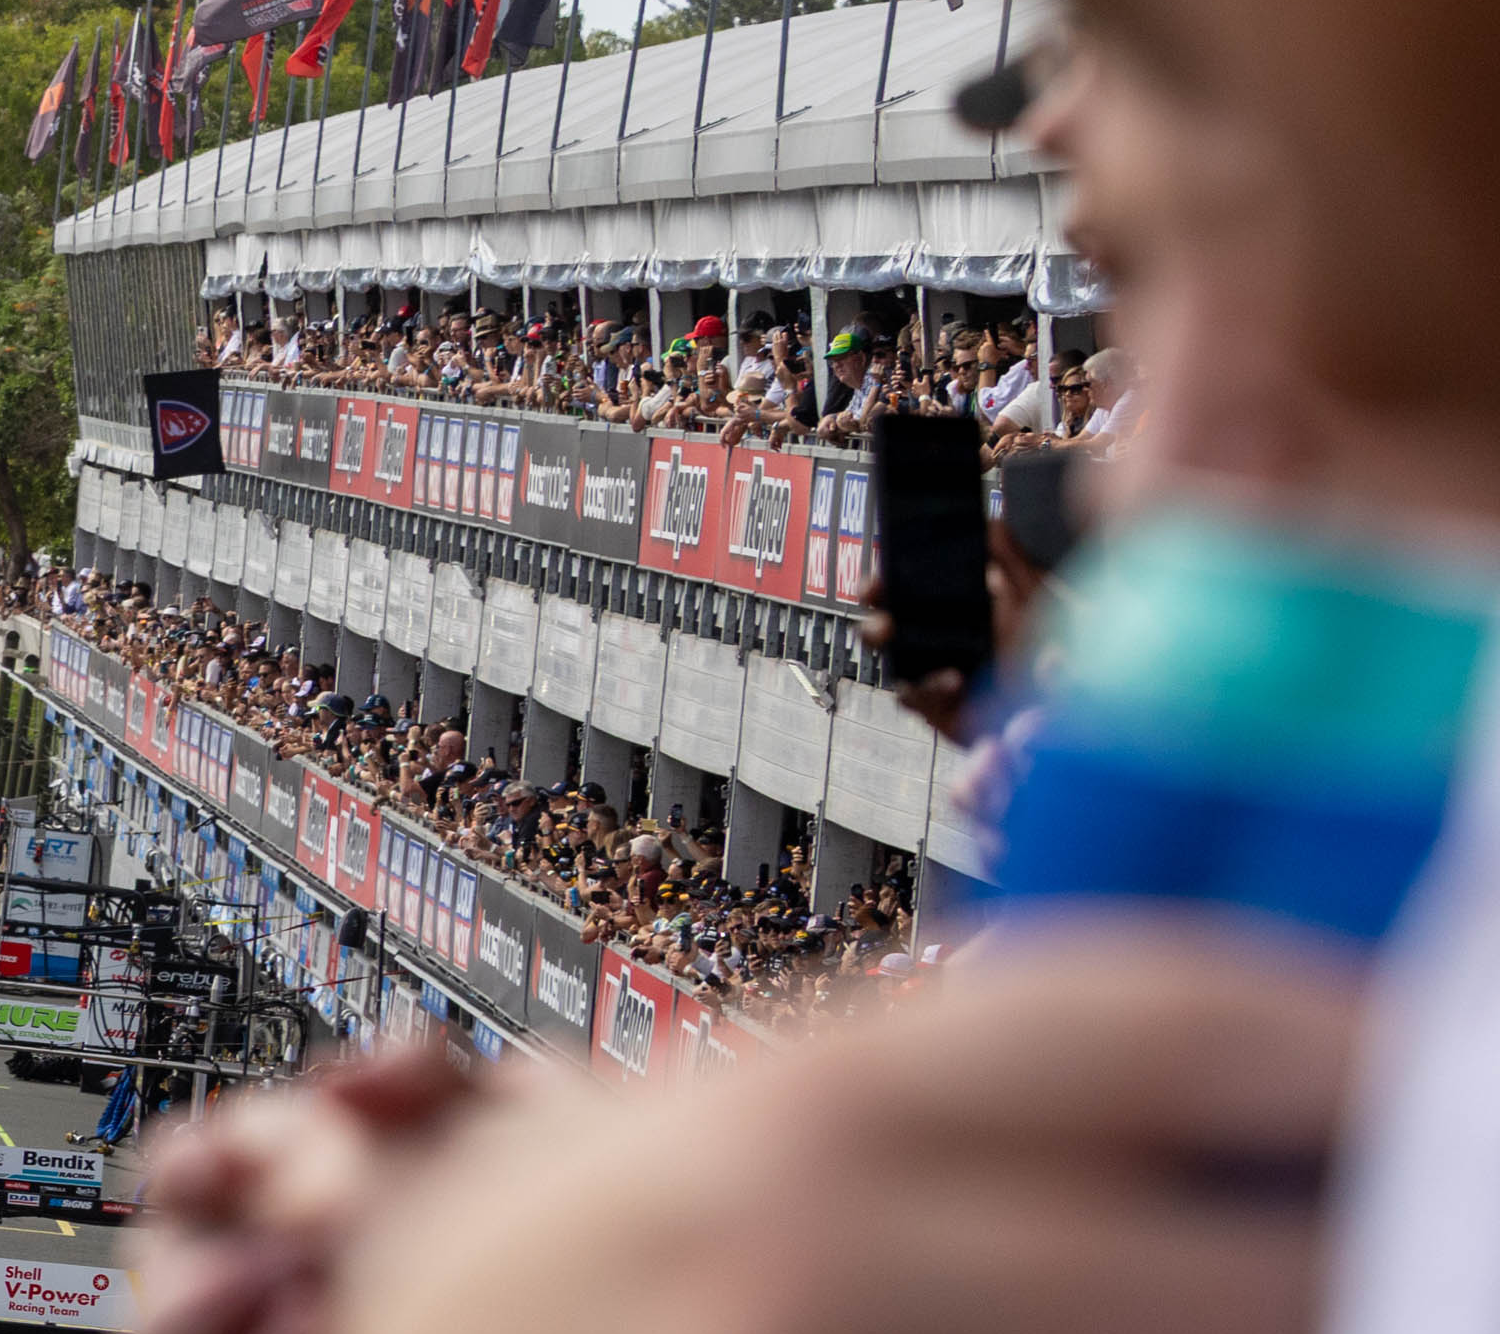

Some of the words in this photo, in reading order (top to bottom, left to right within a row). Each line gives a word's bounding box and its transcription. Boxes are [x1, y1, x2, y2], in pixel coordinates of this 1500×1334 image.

[22, 1150, 96, 1172] Bendix
[58, 1171, 95, 1180] RACING
[8, 1193, 39, 1203] DAF
[5, 1266, 42, 1281] Shell
[4, 1281, 101, 1307] V-Power
[8, 1301, 46, 1316] Racing
[49, 1305, 80, 1317] Team
